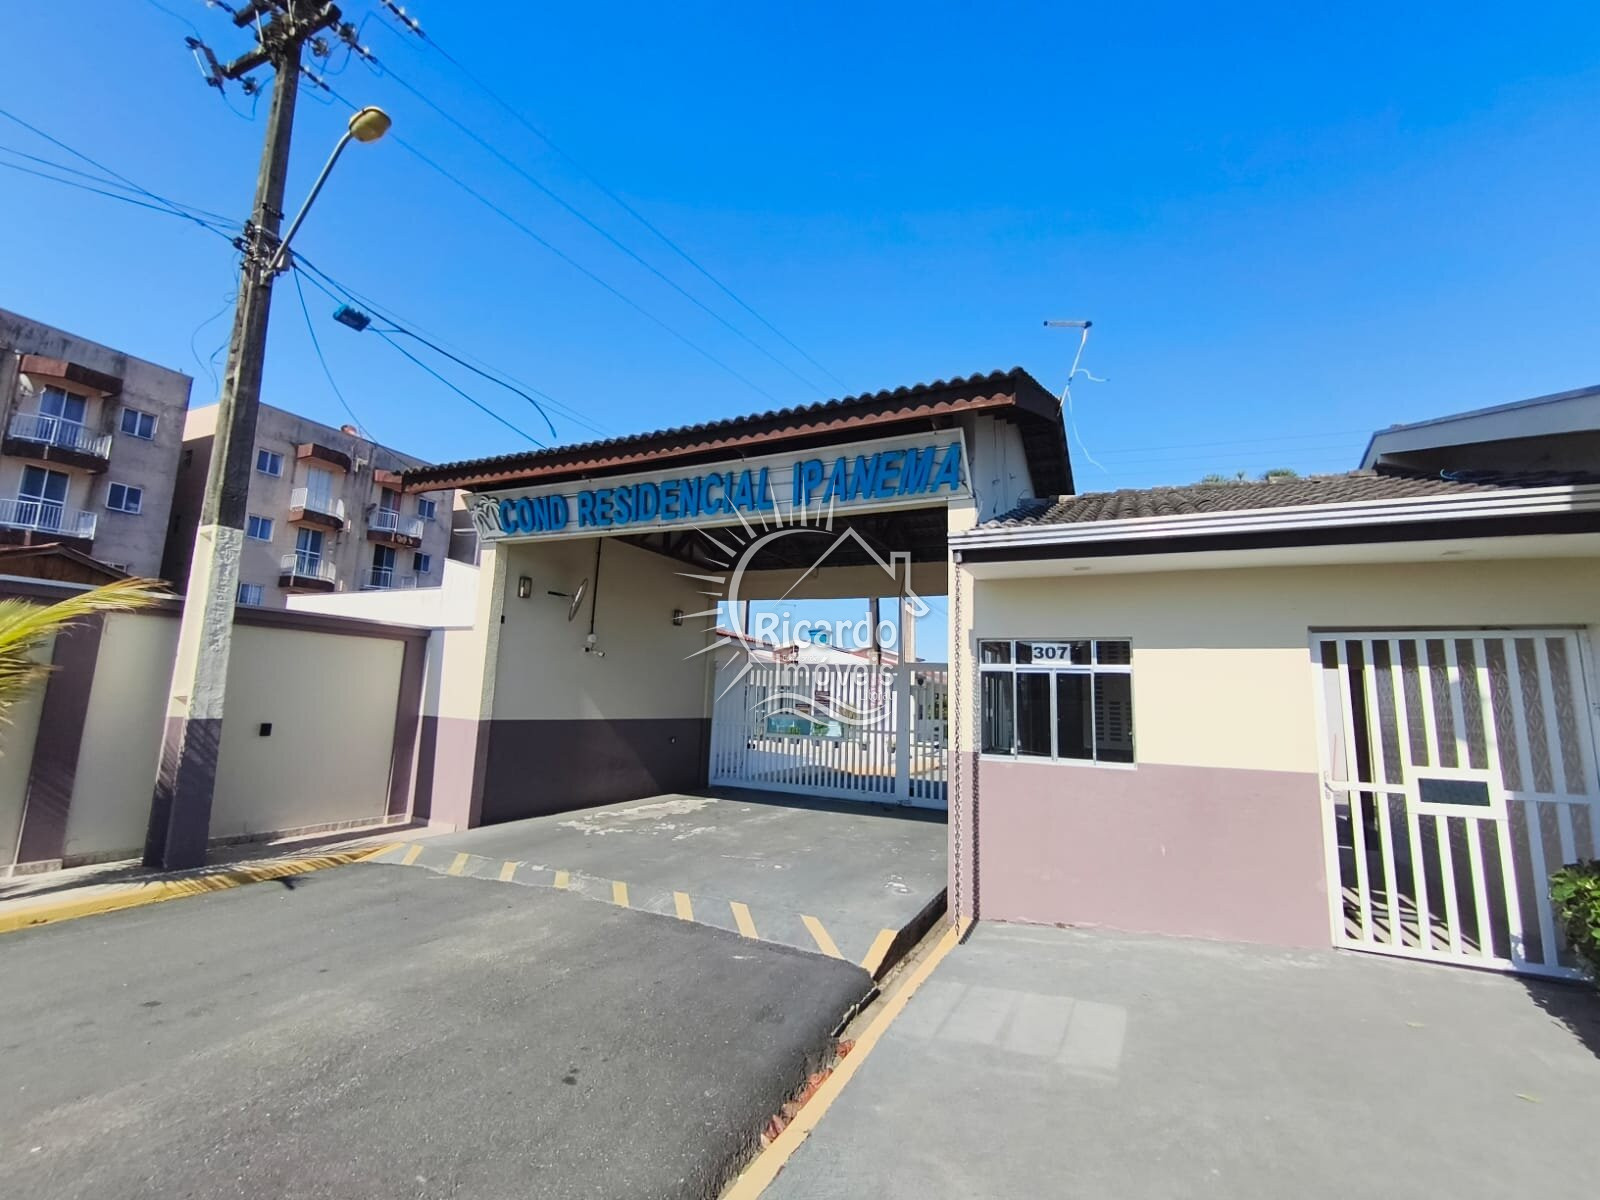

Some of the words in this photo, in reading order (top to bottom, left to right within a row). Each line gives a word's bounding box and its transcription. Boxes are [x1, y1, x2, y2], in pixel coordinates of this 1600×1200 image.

[499, 495, 570, 535] COND
[577, 467, 774, 528] RESIDENCIAL
[792, 441, 962, 507] IPANEMA
[1033, 646, 1069, 660] 307
